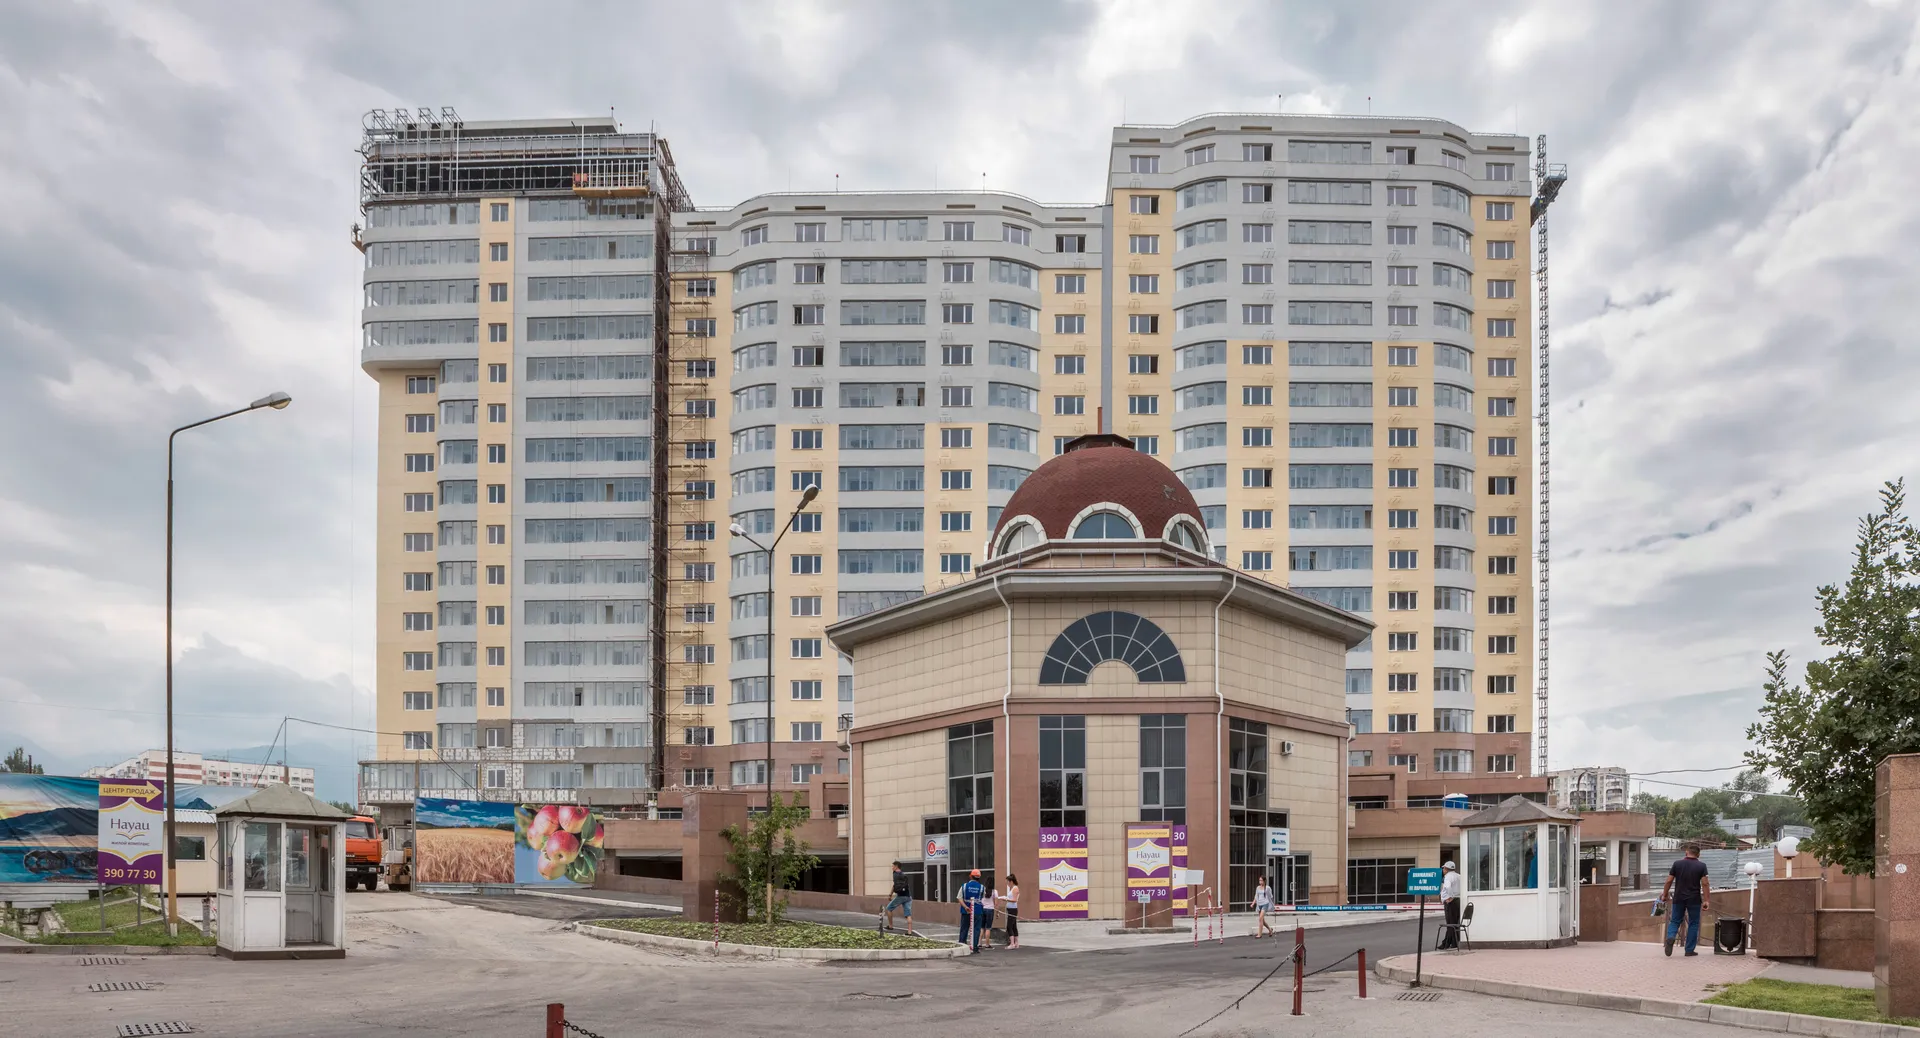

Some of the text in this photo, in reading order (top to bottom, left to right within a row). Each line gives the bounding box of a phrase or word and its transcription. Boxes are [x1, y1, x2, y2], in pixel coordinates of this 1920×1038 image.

[110, 818, 150, 834] Hayau
[1041, 833, 1085, 843] 390 77 30
[1173, 831, 1185, 841] 30
[1136, 850, 1160, 861] Hayau
[104, 868, 156, 879] 390 77 30
[1049, 873, 1077, 884] Hayau
[1131, 889, 1145, 897] 390
[1157, 888, 1166, 896] 30
